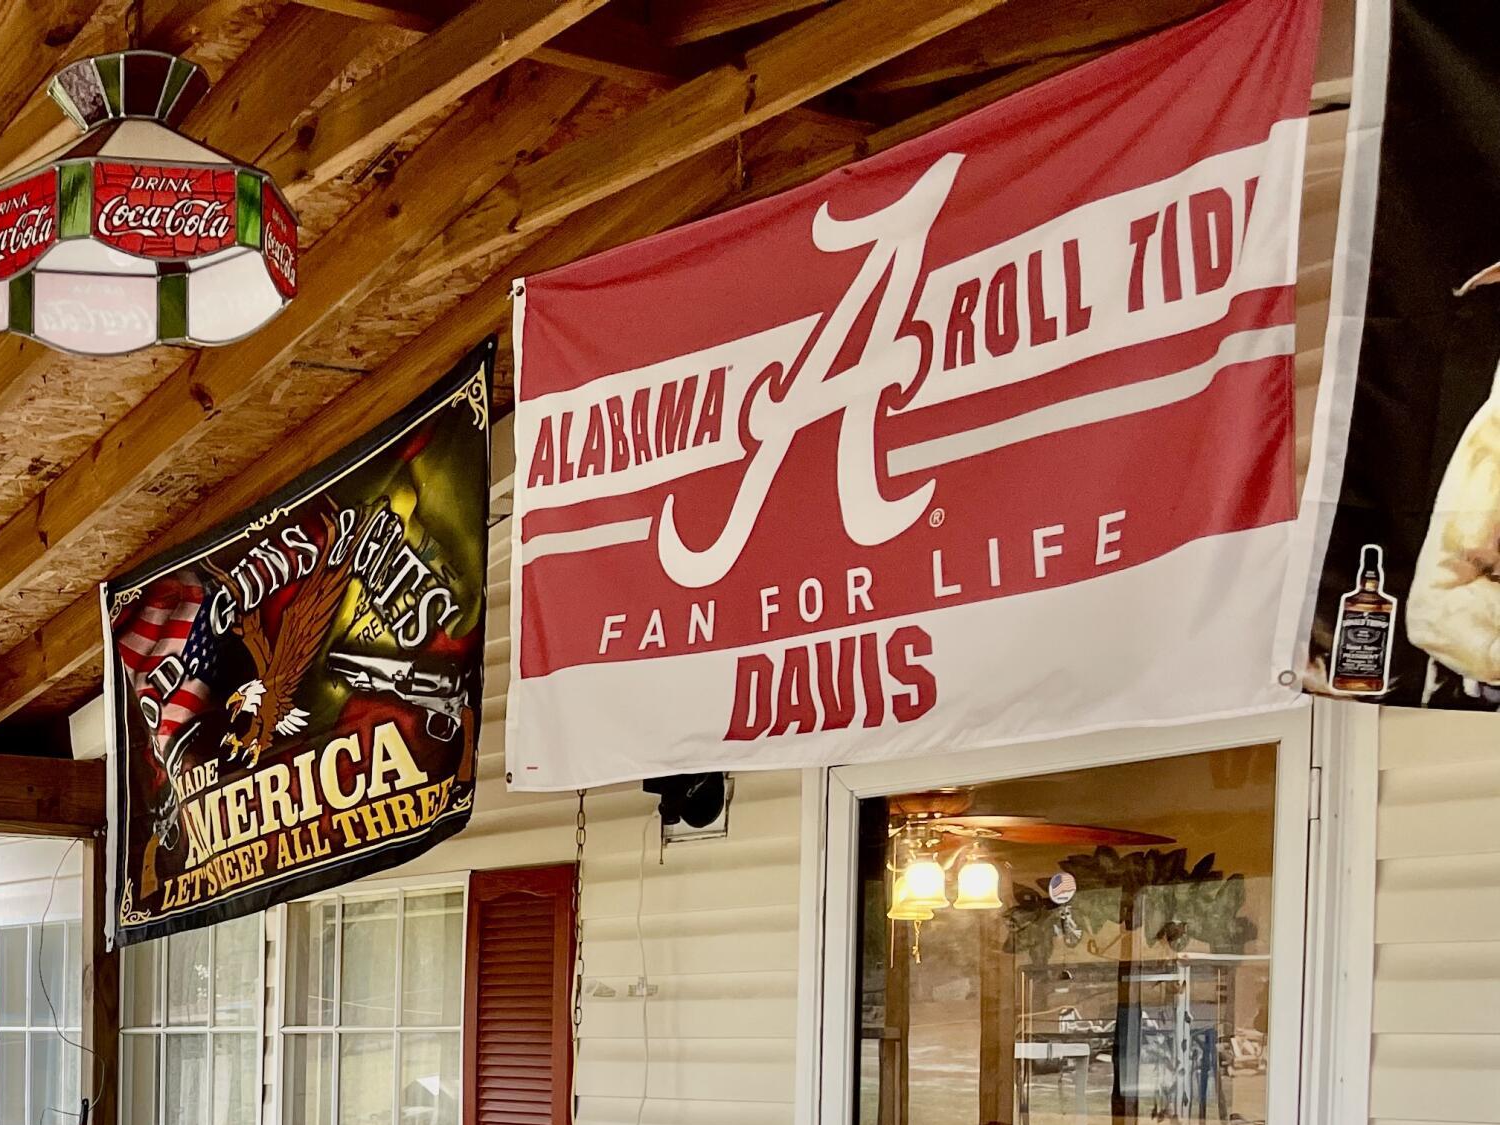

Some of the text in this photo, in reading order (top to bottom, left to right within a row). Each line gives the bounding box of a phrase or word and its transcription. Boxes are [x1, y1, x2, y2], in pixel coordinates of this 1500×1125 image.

[99, 196, 230, 239] Coca-Cola
[130, 176, 196, 193] DRINK
[527, 366, 727, 488] ALABAMA
[943, 239, 1093, 371] ROLL
[209, 525, 319, 636] GUNS
[328, 509, 356, 567] &
[599, 509, 1127, 655] FAN FOR LIFE
[722, 625, 938, 741] DAVIS
[174, 758, 220, 804] MADE
[183, 720, 428, 870] AMERICA
[276, 819, 332, 870] ALL
